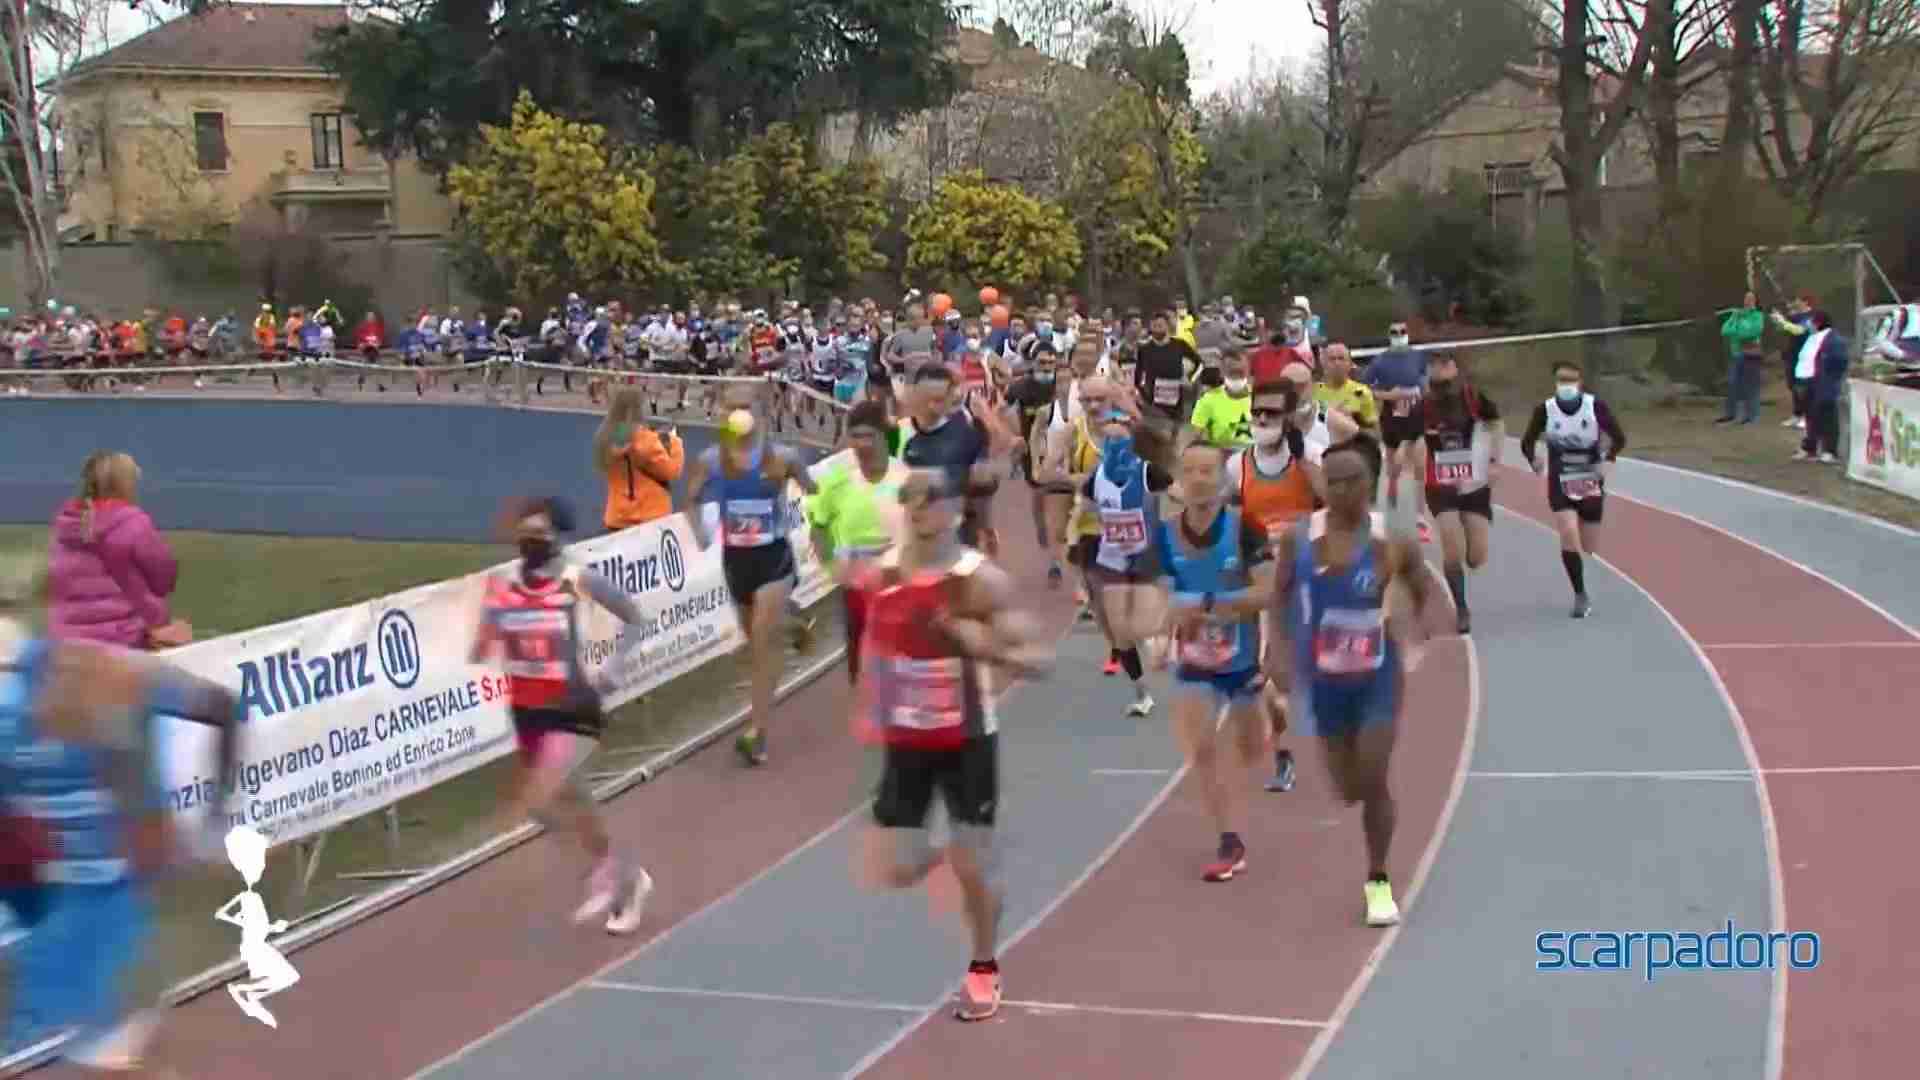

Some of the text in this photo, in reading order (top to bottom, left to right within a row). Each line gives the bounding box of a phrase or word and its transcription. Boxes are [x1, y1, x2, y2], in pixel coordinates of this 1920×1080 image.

[660, 588, 718, 630] CARNEVALE
[237, 642, 375, 722] Allianz
[232, 743, 324, 794] igevano
[329, 725, 372, 758] Diaz
[374, 679, 480, 741] CARNEVALE
[250, 780, 329, 821] Carnevale
[331, 759, 382, 793] Bonino
[386, 748, 401, 772] ed
